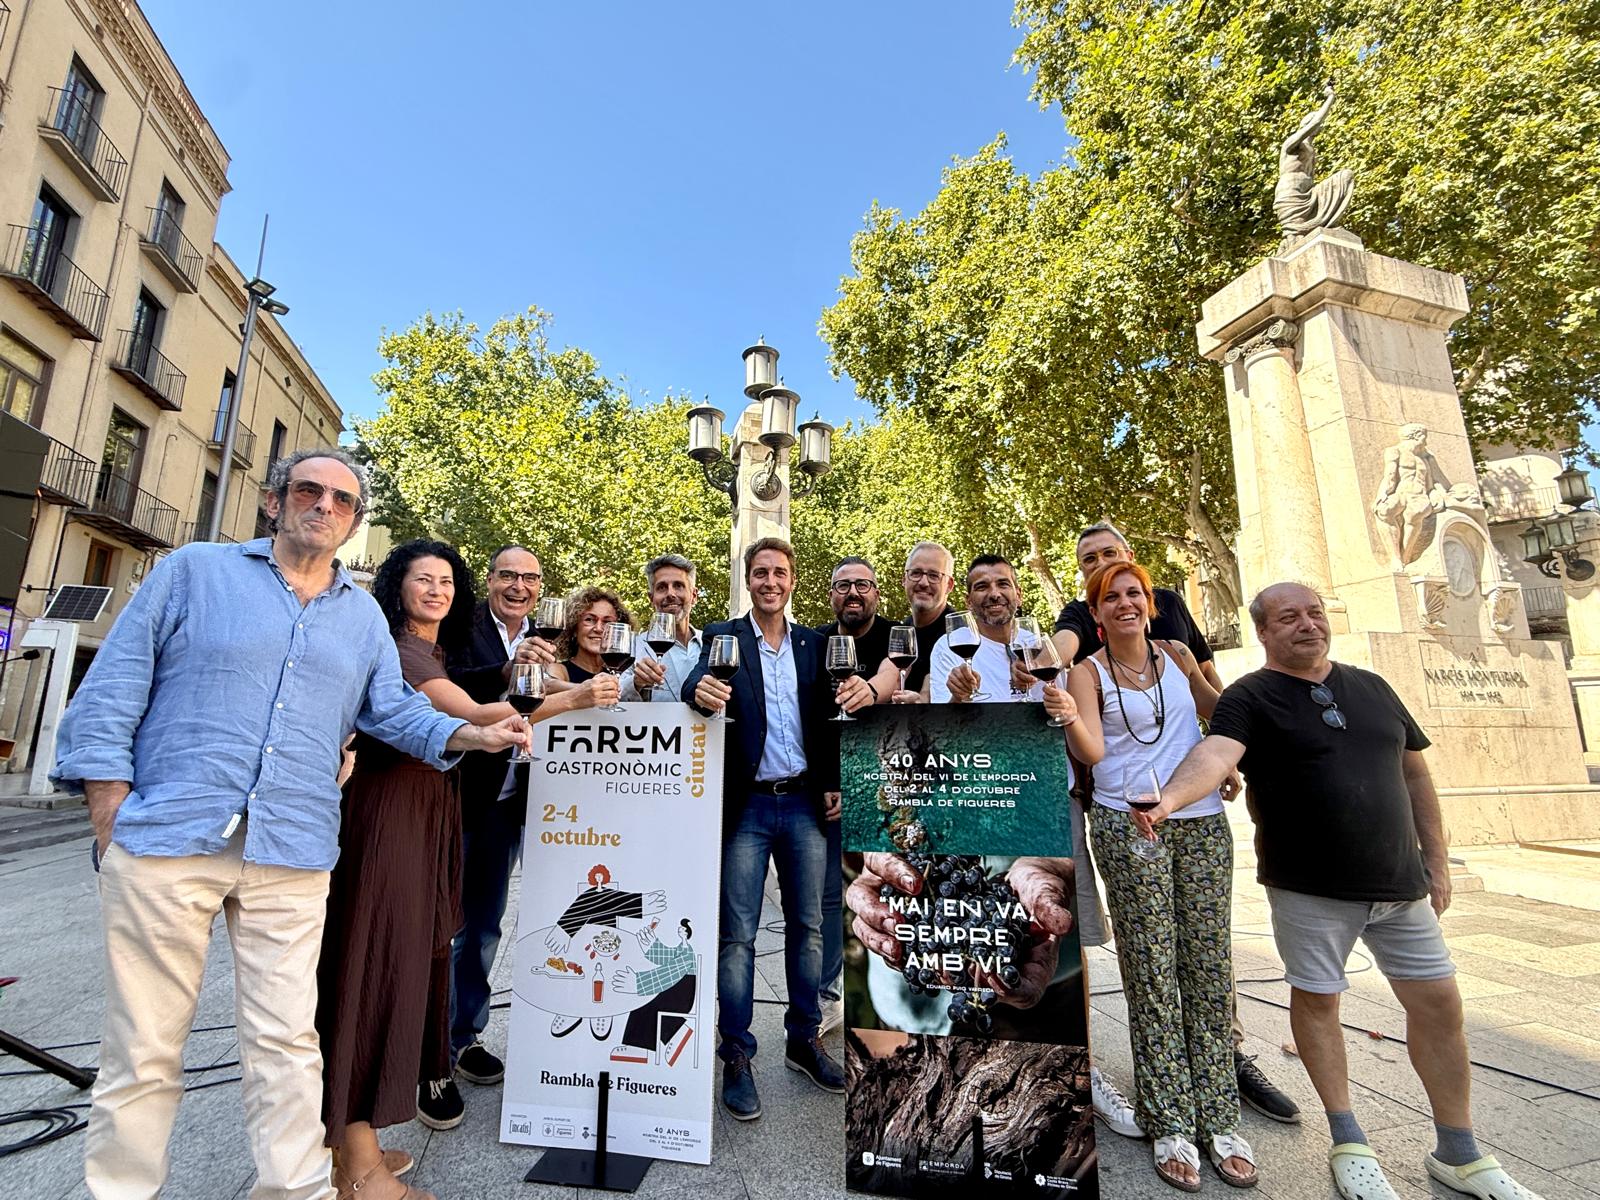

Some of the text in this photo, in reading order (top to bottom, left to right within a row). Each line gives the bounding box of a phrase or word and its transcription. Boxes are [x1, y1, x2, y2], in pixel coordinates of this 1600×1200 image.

[546, 759, 682, 777] GASTRONÒMIC
[685, 723, 707, 798] ciutat
[889, 753, 992, 768] 40 ANYS
[863, 773, 909, 781] MOSTRA
[913, 773, 935, 781] DEL
[973, 771, 1037, 782] L'EMPORDÀ
[605, 782, 681, 795] FIGUERES
[884, 784, 1021, 795] DEL 2 AL 4 D'OCTUBRE
[888, 799, 933, 807] RAMBLA
[958, 800, 1016, 808] FIGUERES
[542, 804, 578, 823] 2-4
[540, 827, 621, 847] octubre
[943, 899, 982, 918] EN
[894, 924, 1009, 946] SEMPRE
[905, 951, 964, 972] AMB
[540, 1070, 594, 1088] Rambla
[617, 1076, 677, 1096] Figueres
